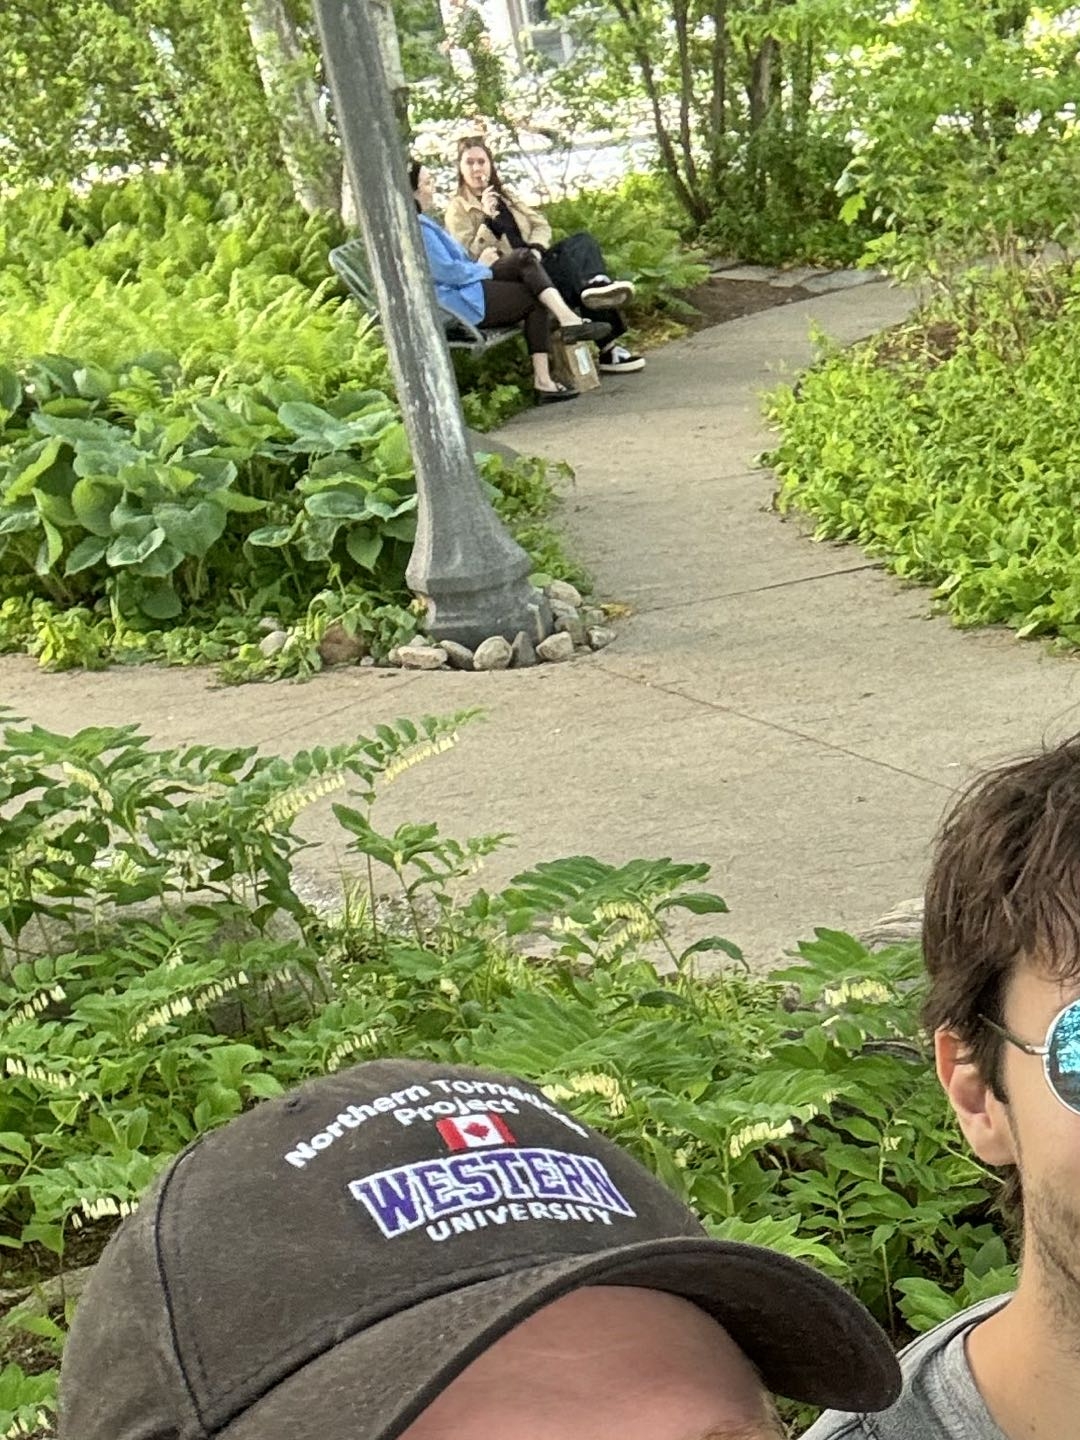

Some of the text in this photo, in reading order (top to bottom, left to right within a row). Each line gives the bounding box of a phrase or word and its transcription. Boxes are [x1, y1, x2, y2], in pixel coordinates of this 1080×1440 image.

[284, 1085, 431, 1168] Northern
[393, 1097, 520, 1127] Project
[348, 1148, 637, 1239] WESTERN
[426, 1202, 613, 1241] UNIVERSITY
